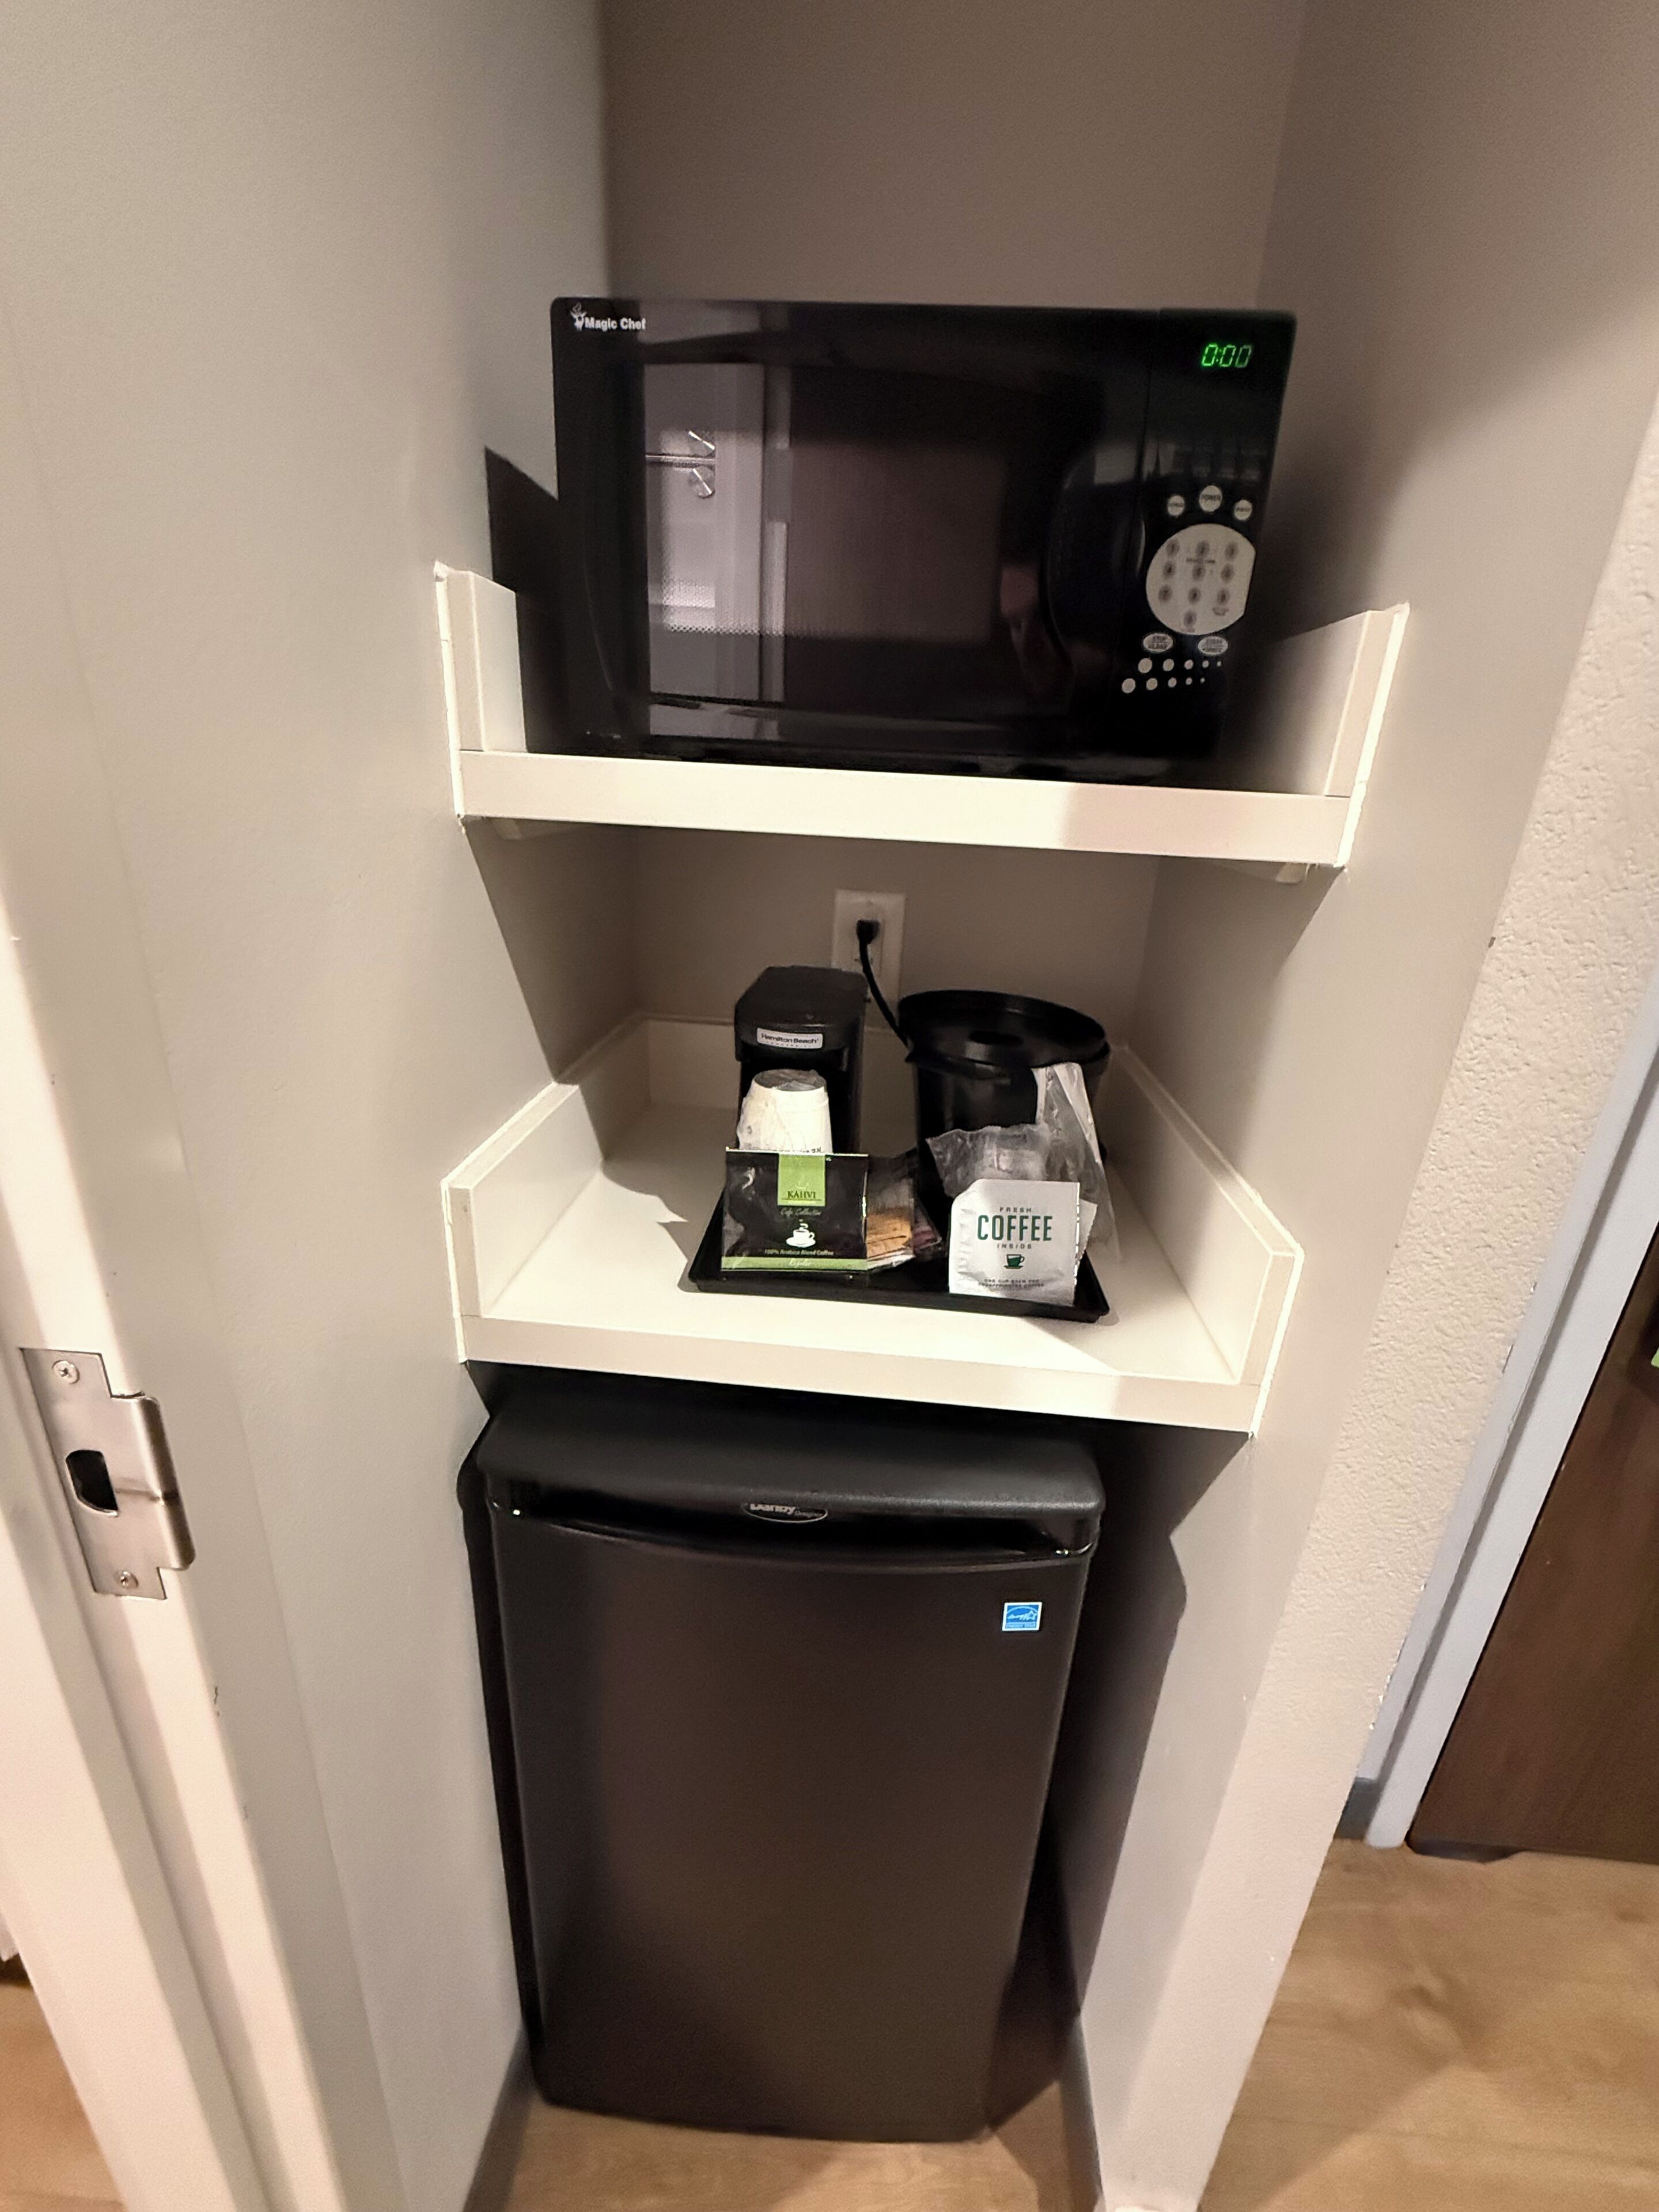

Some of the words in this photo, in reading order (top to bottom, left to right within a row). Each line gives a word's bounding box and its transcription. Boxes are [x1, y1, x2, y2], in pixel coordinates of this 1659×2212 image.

[585, 317, 618, 332] Magic
[620, 317, 646, 330] Chef
[1202, 343, 1252, 368] 0:00
[761, 1033, 793, 1043] Hamilton
[787, 1190, 816, 1199] KAHVI
[978, 1214, 1053, 1241] COFFEE
